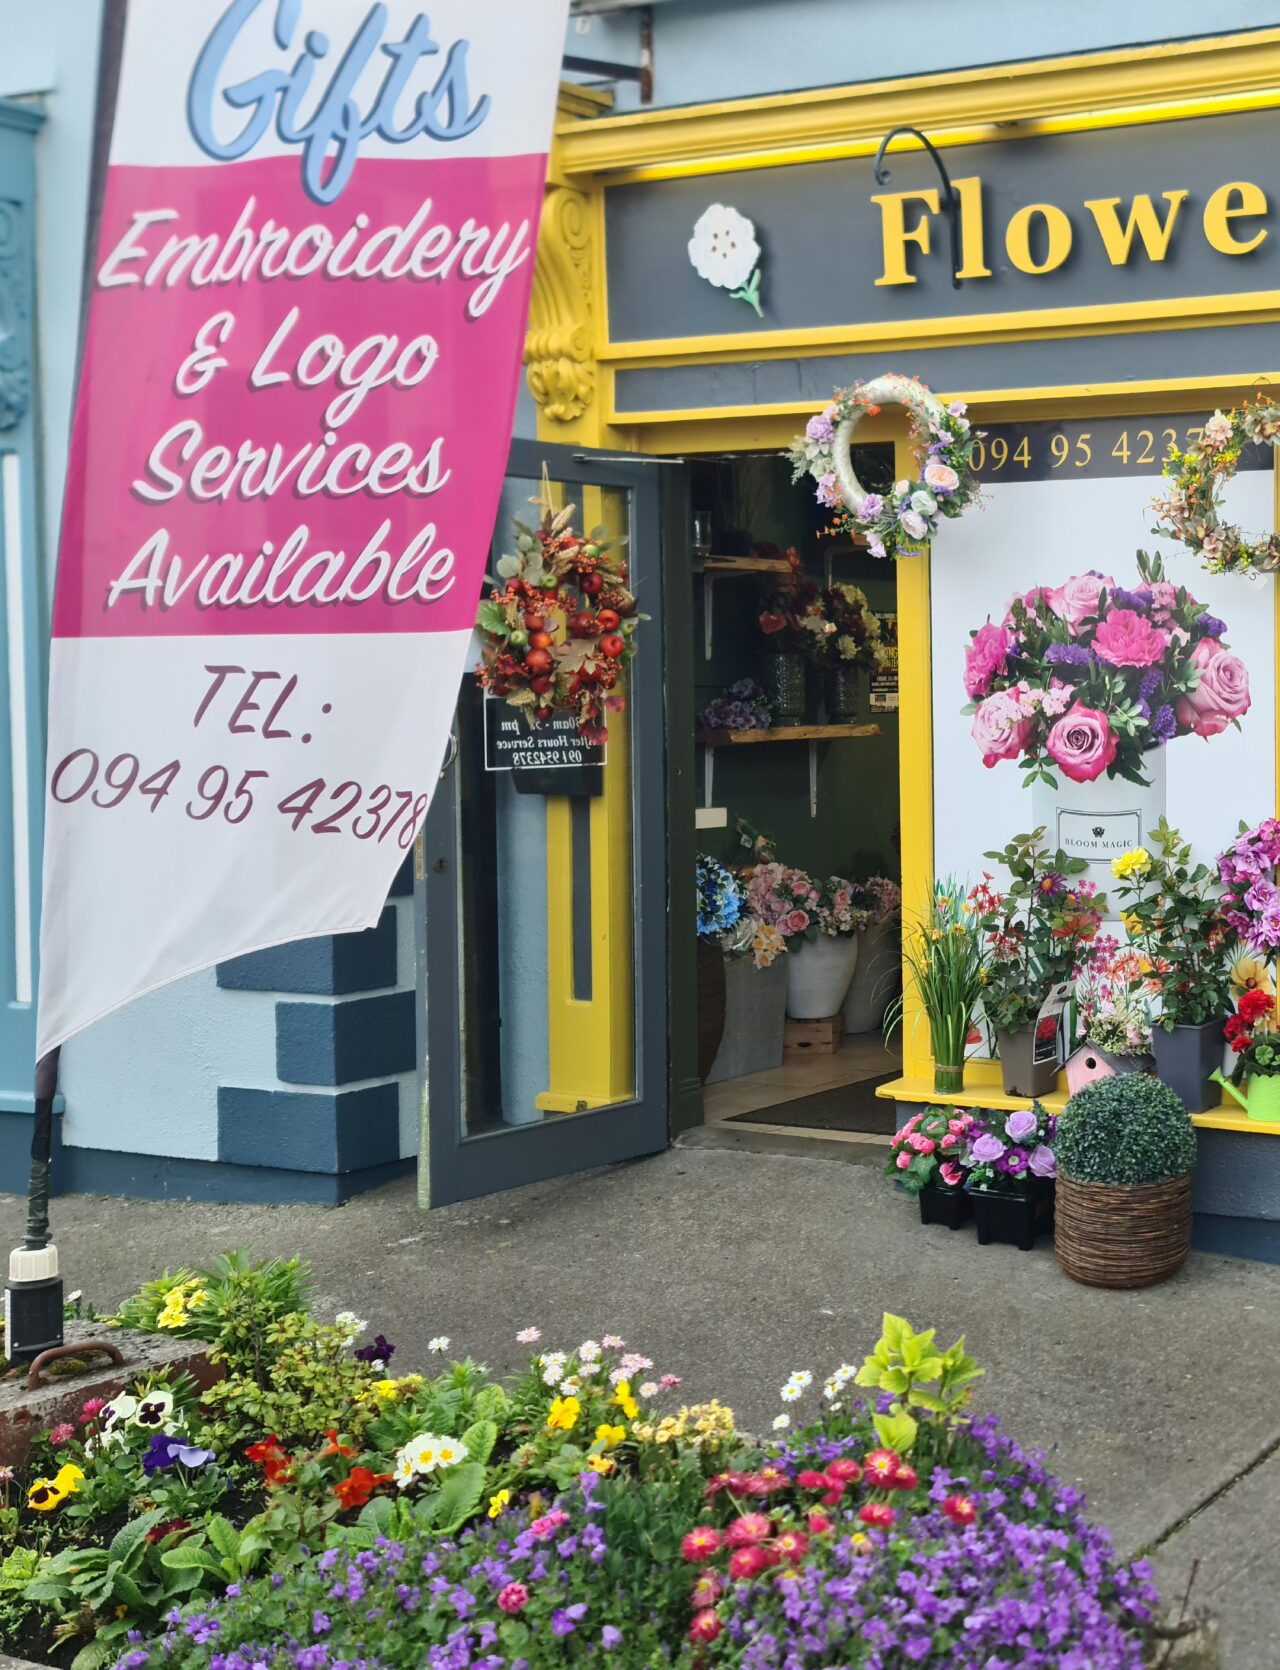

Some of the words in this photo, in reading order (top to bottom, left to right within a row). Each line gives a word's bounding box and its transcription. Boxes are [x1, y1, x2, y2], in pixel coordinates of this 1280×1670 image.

[186, 0, 492, 207] Gifts
[97, 195, 531, 320] Embroidery
[175, 311, 235, 396] &
[249, 306, 439, 430] Logo
[132, 419, 452, 503] Services
[968, 437, 1032, 471] 094
[1051, 433, 1092, 467] 95
[1111, 427, 1206, 465] 4237
[108, 518, 456, 608] Available
[193, 665, 332, 744] TEL:
[51, 748, 181, 813] 094
[185, 764, 269, 824] 95
[277, 777, 428, 849] 42378
[1065, 837, 1098, 848] BLOOM
[1102, 839, 1133, 848] MAGIC
